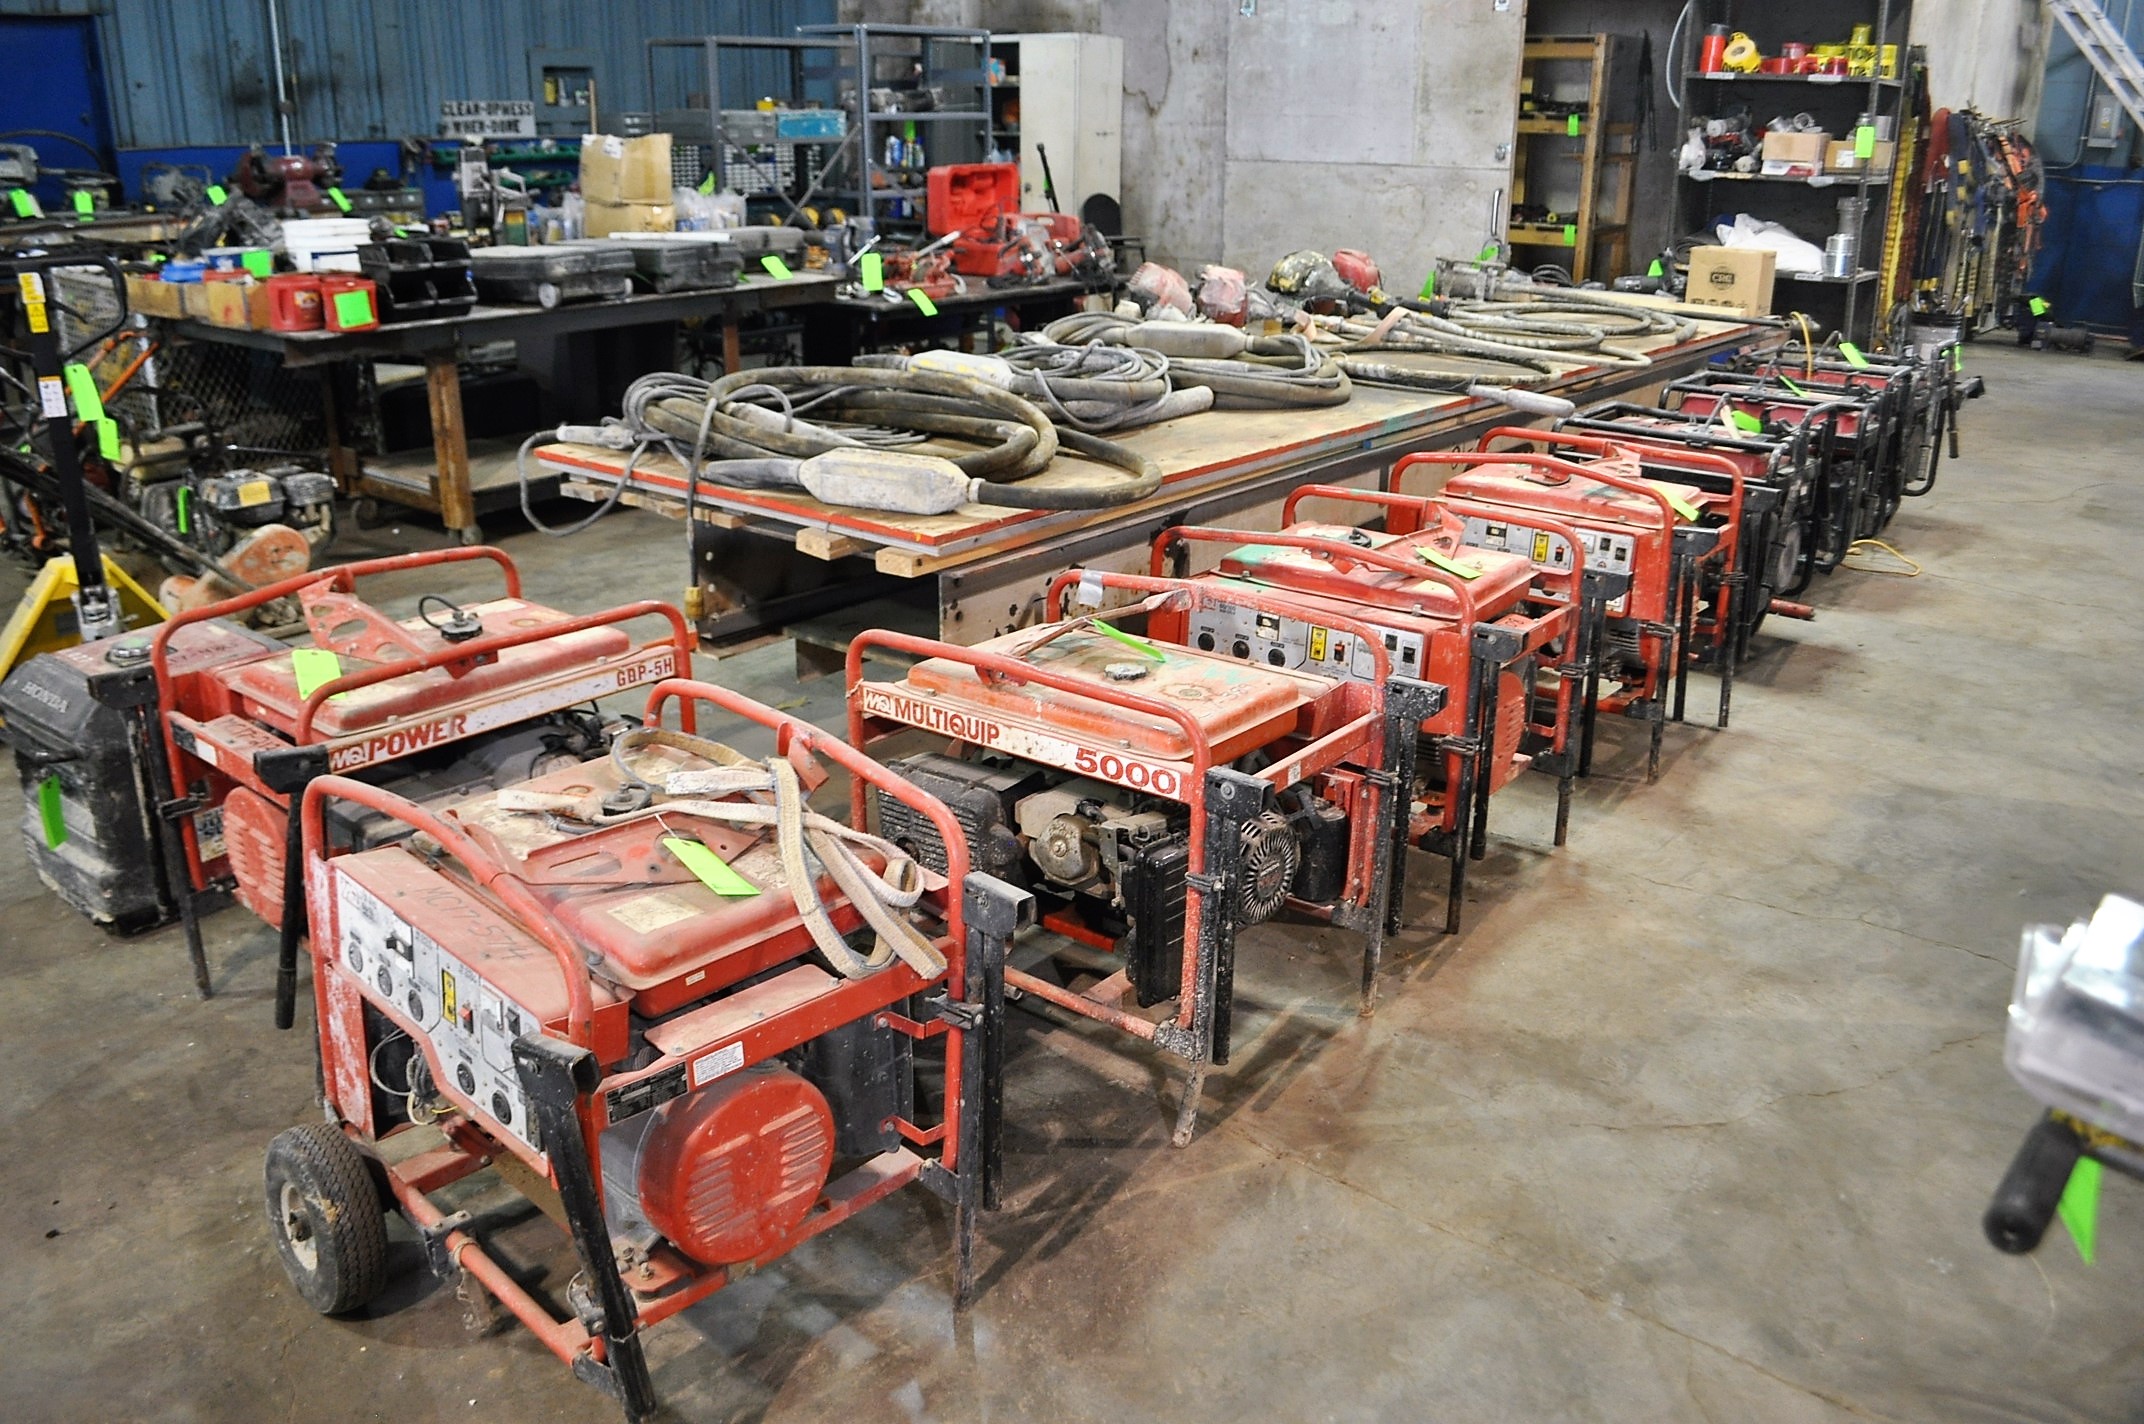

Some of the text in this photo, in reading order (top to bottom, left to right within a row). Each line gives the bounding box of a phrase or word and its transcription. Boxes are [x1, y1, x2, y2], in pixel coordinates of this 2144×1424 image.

[21, 680, 70, 713] HONDA
[366, 713, 467, 761] POWER
[895, 699, 1000, 745] MULTIQUIP
[1074, 747, 1177, 795] 5000
